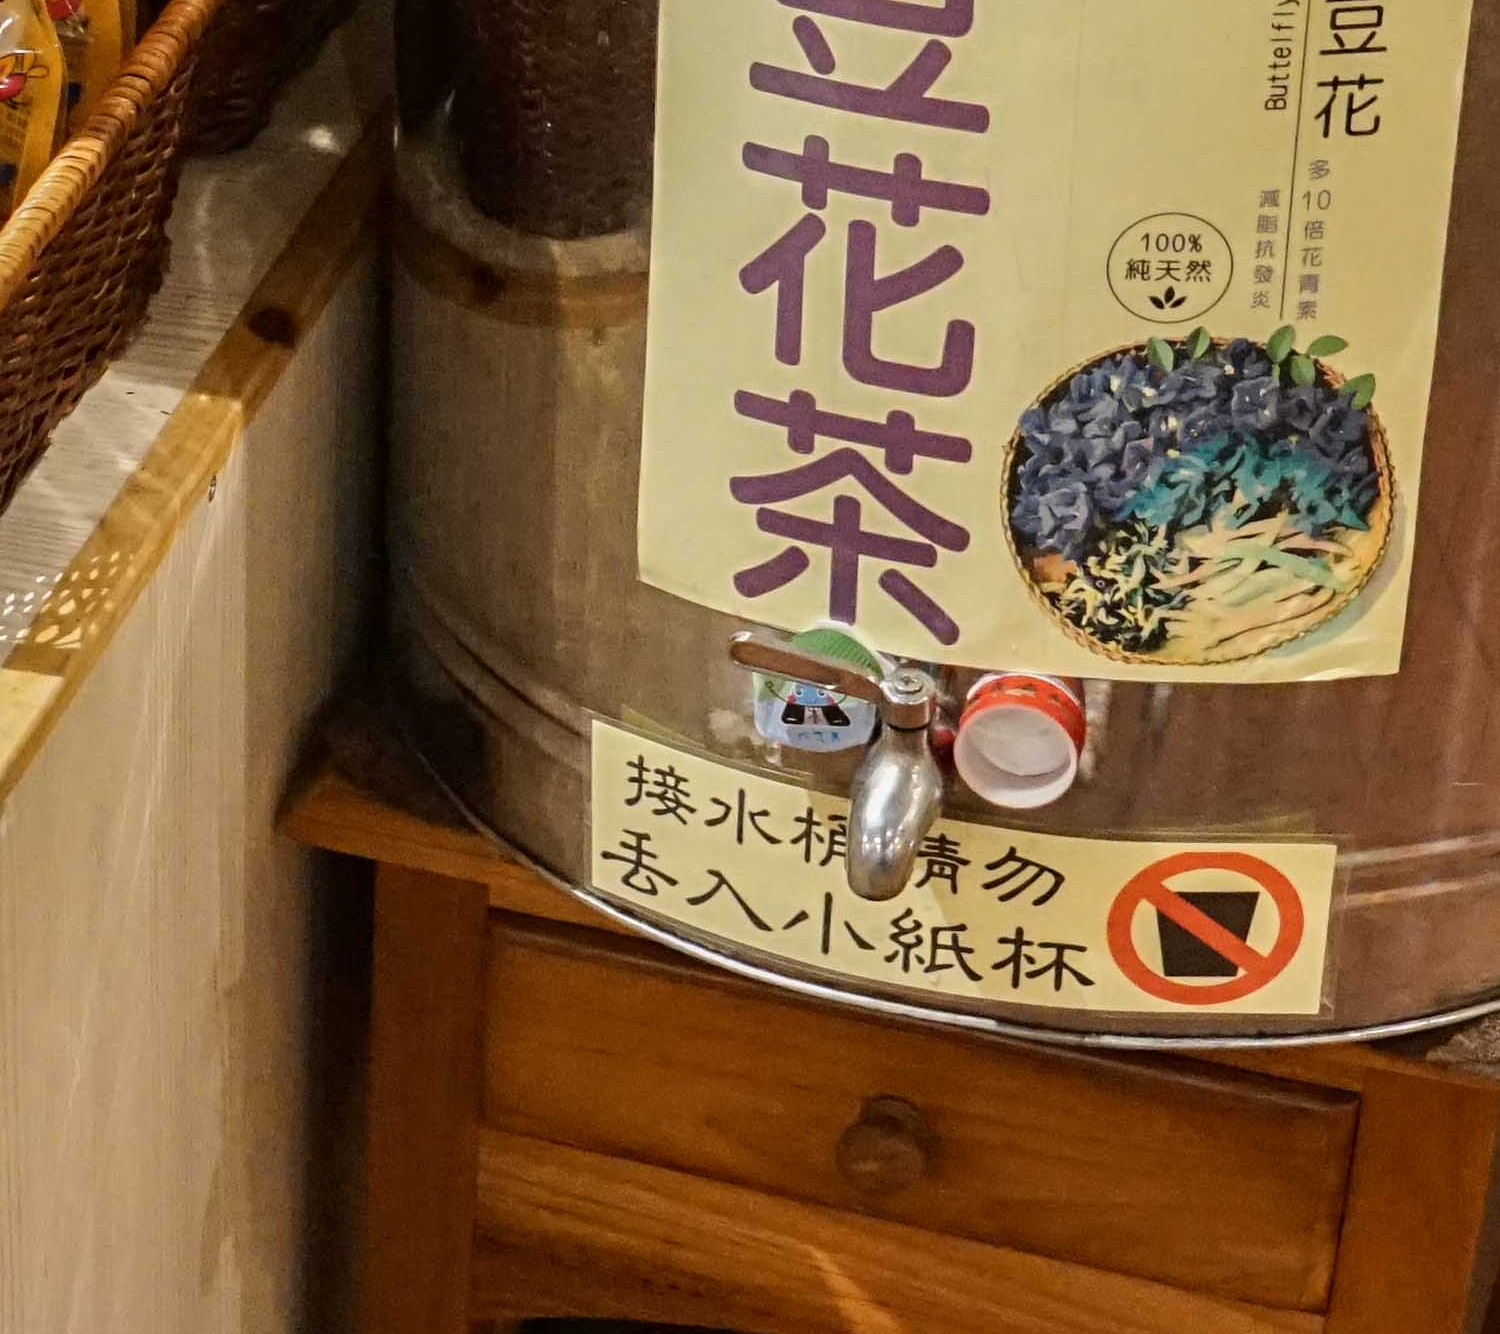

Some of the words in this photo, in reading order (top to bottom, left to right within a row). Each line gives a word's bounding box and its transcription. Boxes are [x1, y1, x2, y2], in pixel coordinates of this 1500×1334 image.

[1140, 233, 1203, 253] 100%
[1124, 258, 1213, 284] 純天然
